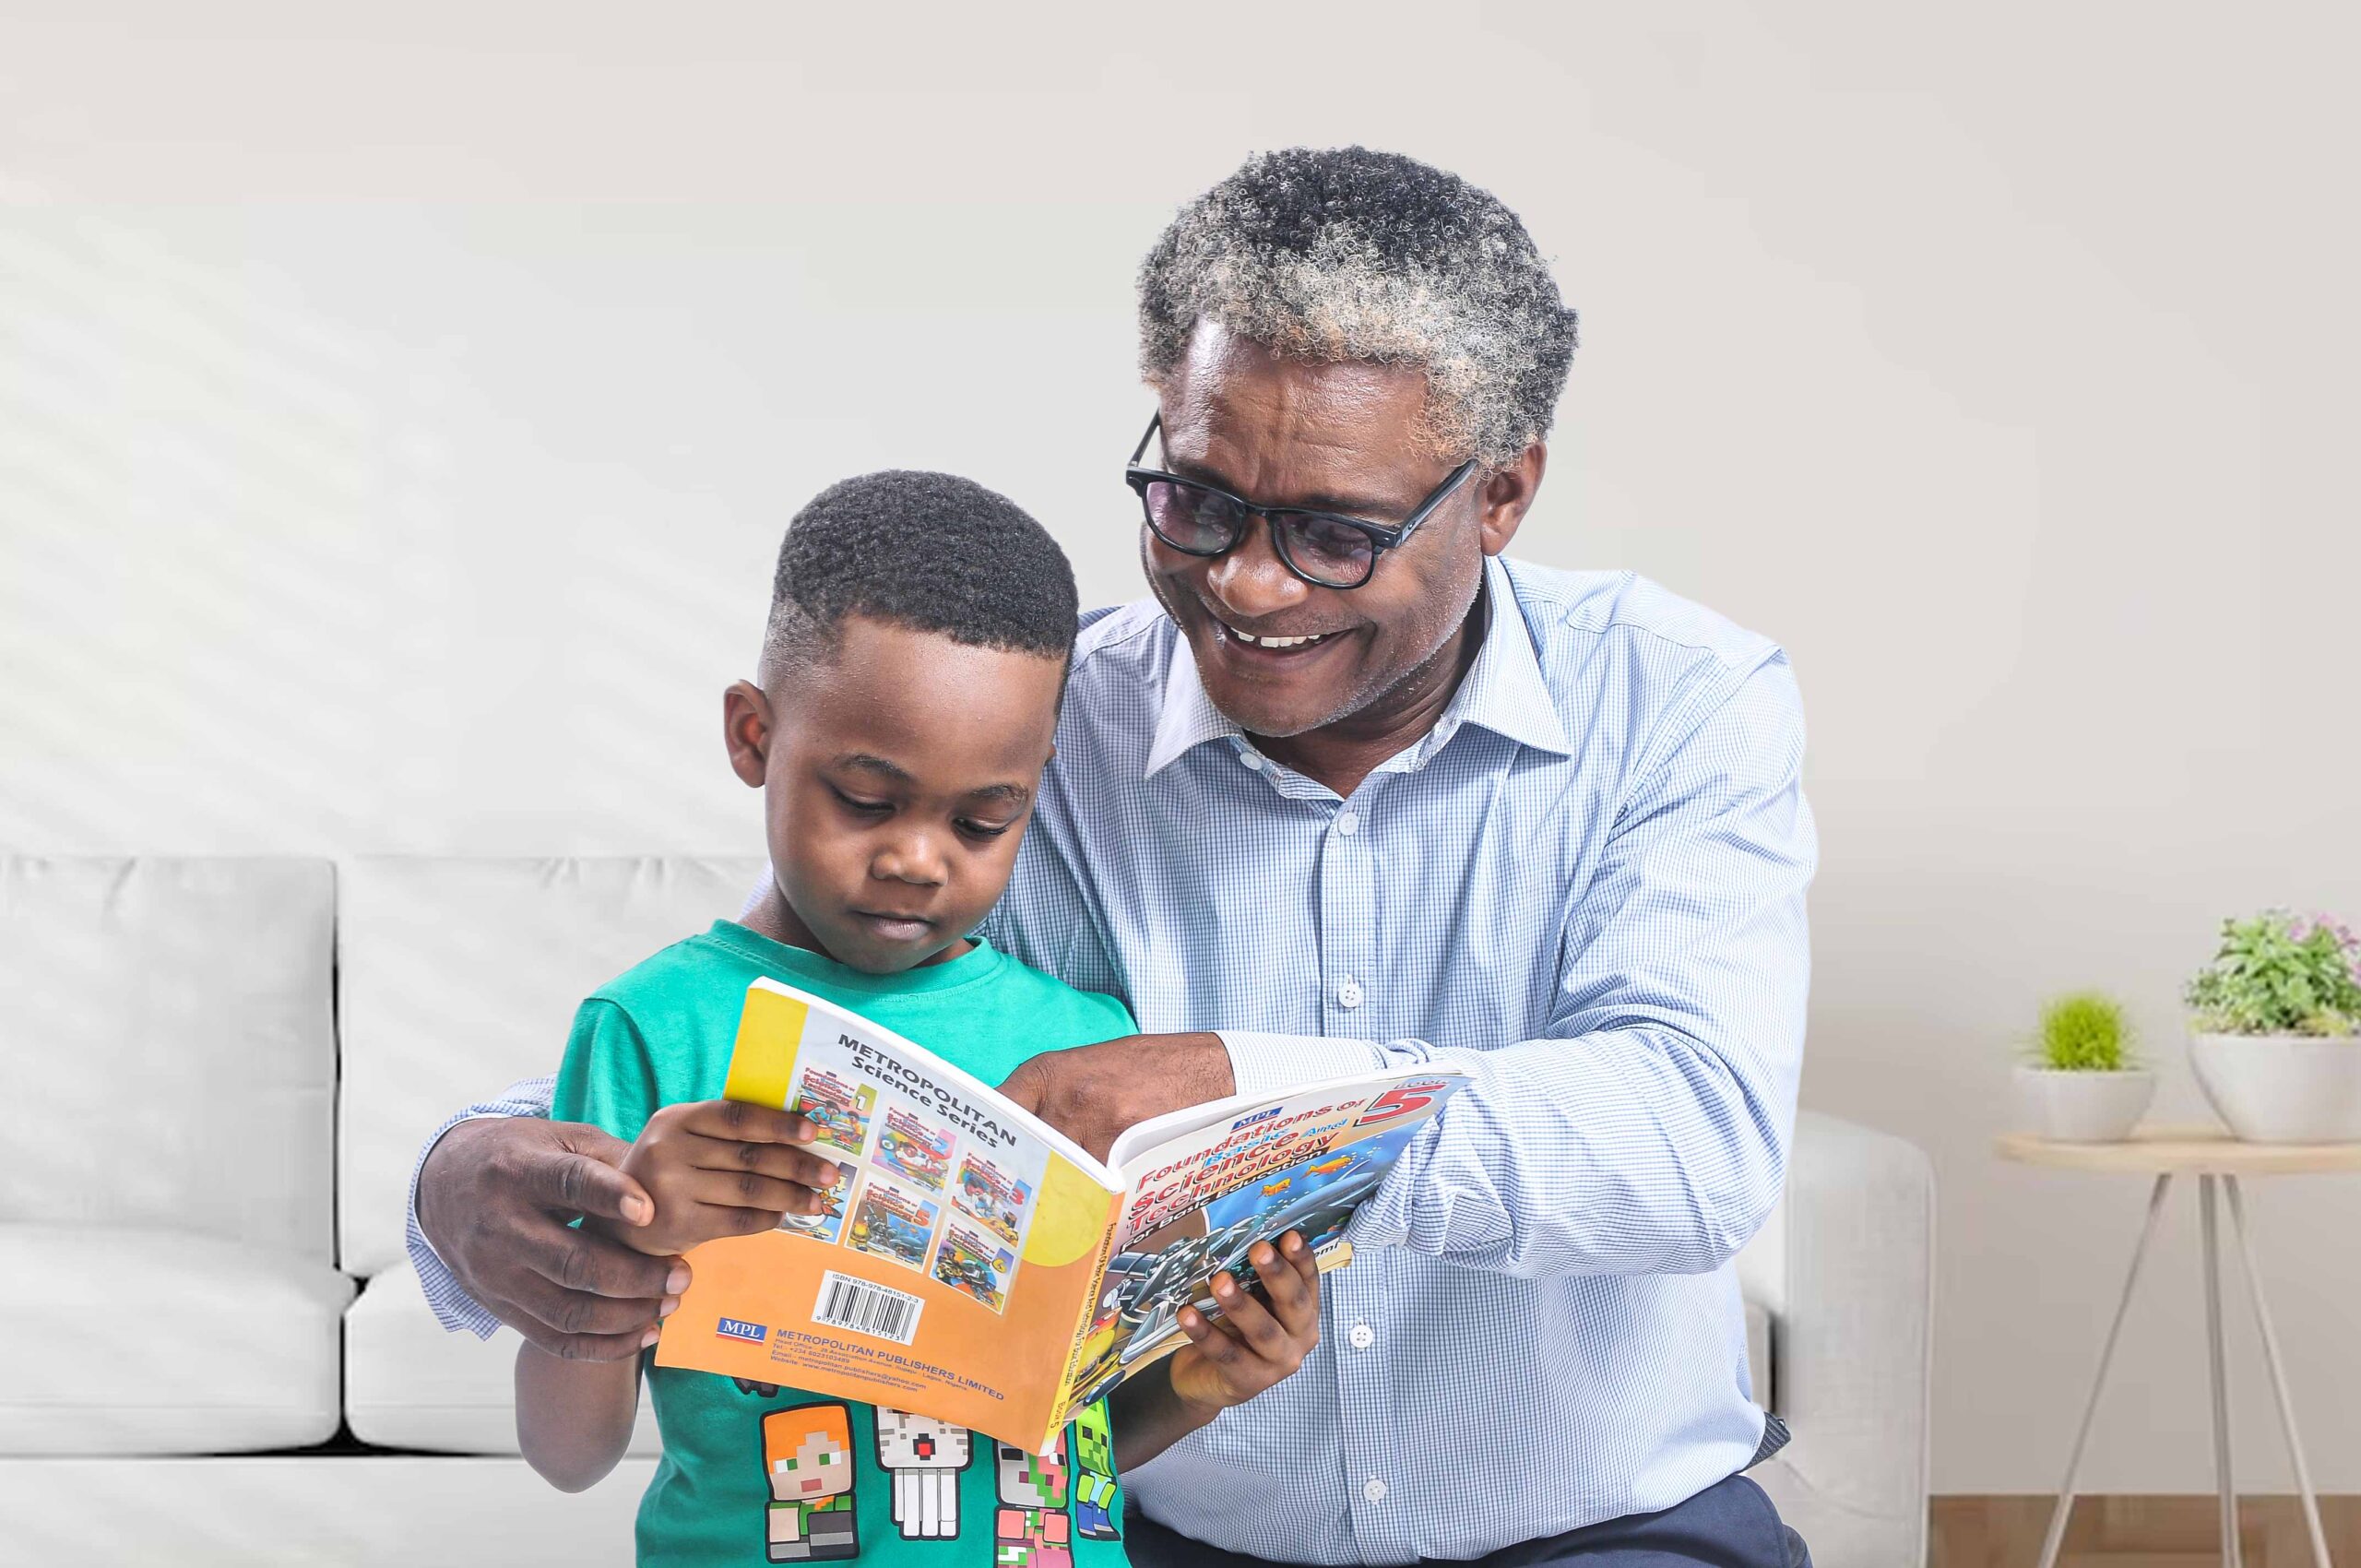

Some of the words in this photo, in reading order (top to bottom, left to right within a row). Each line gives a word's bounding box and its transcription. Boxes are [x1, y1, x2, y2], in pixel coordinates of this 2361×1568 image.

[838, 1034, 1016, 1146] METROPOLITAN
[851, 1056, 931, 1107] Science
[937, 1105, 998, 1148] Series
[856, 1095, 867, 1111] 1
[1353, 1084, 1447, 1127] 5
[1240, 1108, 1278, 1127] MPL
[931, 1136, 948, 1156] 2
[1136, 1105, 1334, 1194] Foundations
[1202, 1127, 1291, 1170] Basic
[1126, 1131, 1340, 1235] Technology
[1128, 1132, 1299, 1219] Science
[1299, 1118, 1348, 1138] And
[914, 1209, 930, 1227] 5
[1009, 1187, 1025, 1206] 3
[1121, 1228, 1154, 1253] For
[1159, 1197, 1211, 1229] Basic
[1216, 1149, 1323, 1199] Education
[992, 1258, 1006, 1274] 6
[832, 1274, 850, 1282] ISBN
[853, 1278, 919, 1304] 978-978-48151-2-3
[723, 1321, 761, 1337] MPL
[777, 1329, 874, 1357] METROPOLITAN
[878, 1351, 955, 1380] PUBLISHERS
[957, 1375, 1004, 1400] LIMITED
